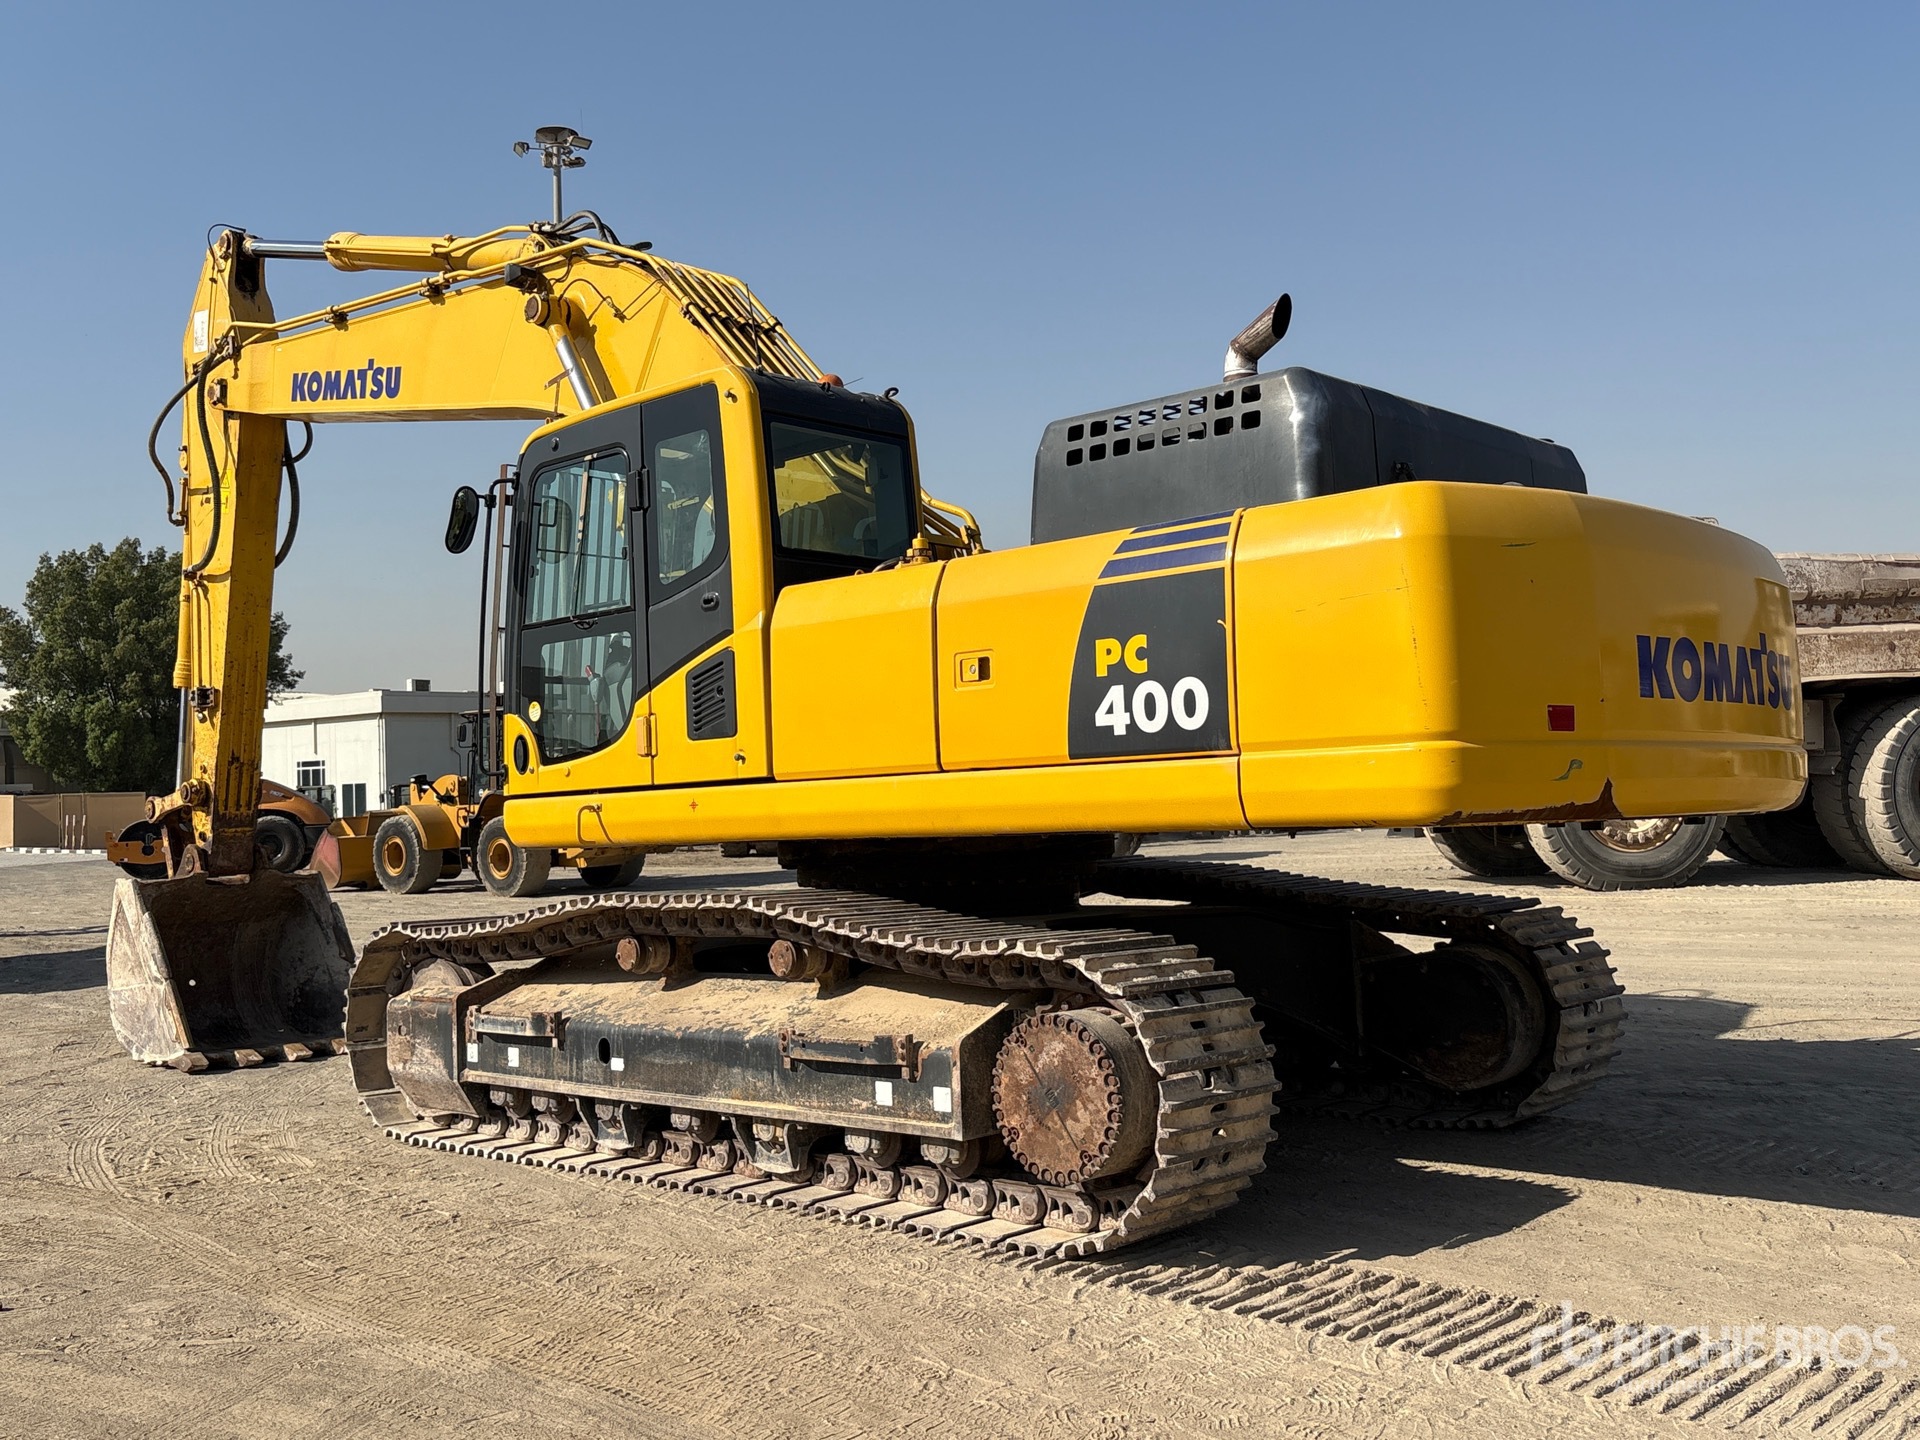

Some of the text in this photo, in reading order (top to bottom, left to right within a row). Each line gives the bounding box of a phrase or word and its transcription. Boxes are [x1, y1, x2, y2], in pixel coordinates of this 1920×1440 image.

[291, 358, 402, 402] KOMATSU
[1095, 633, 1148, 678] PC
[1636, 632, 1792, 711] KOMATSU
[1095, 676, 1209, 736] 400
